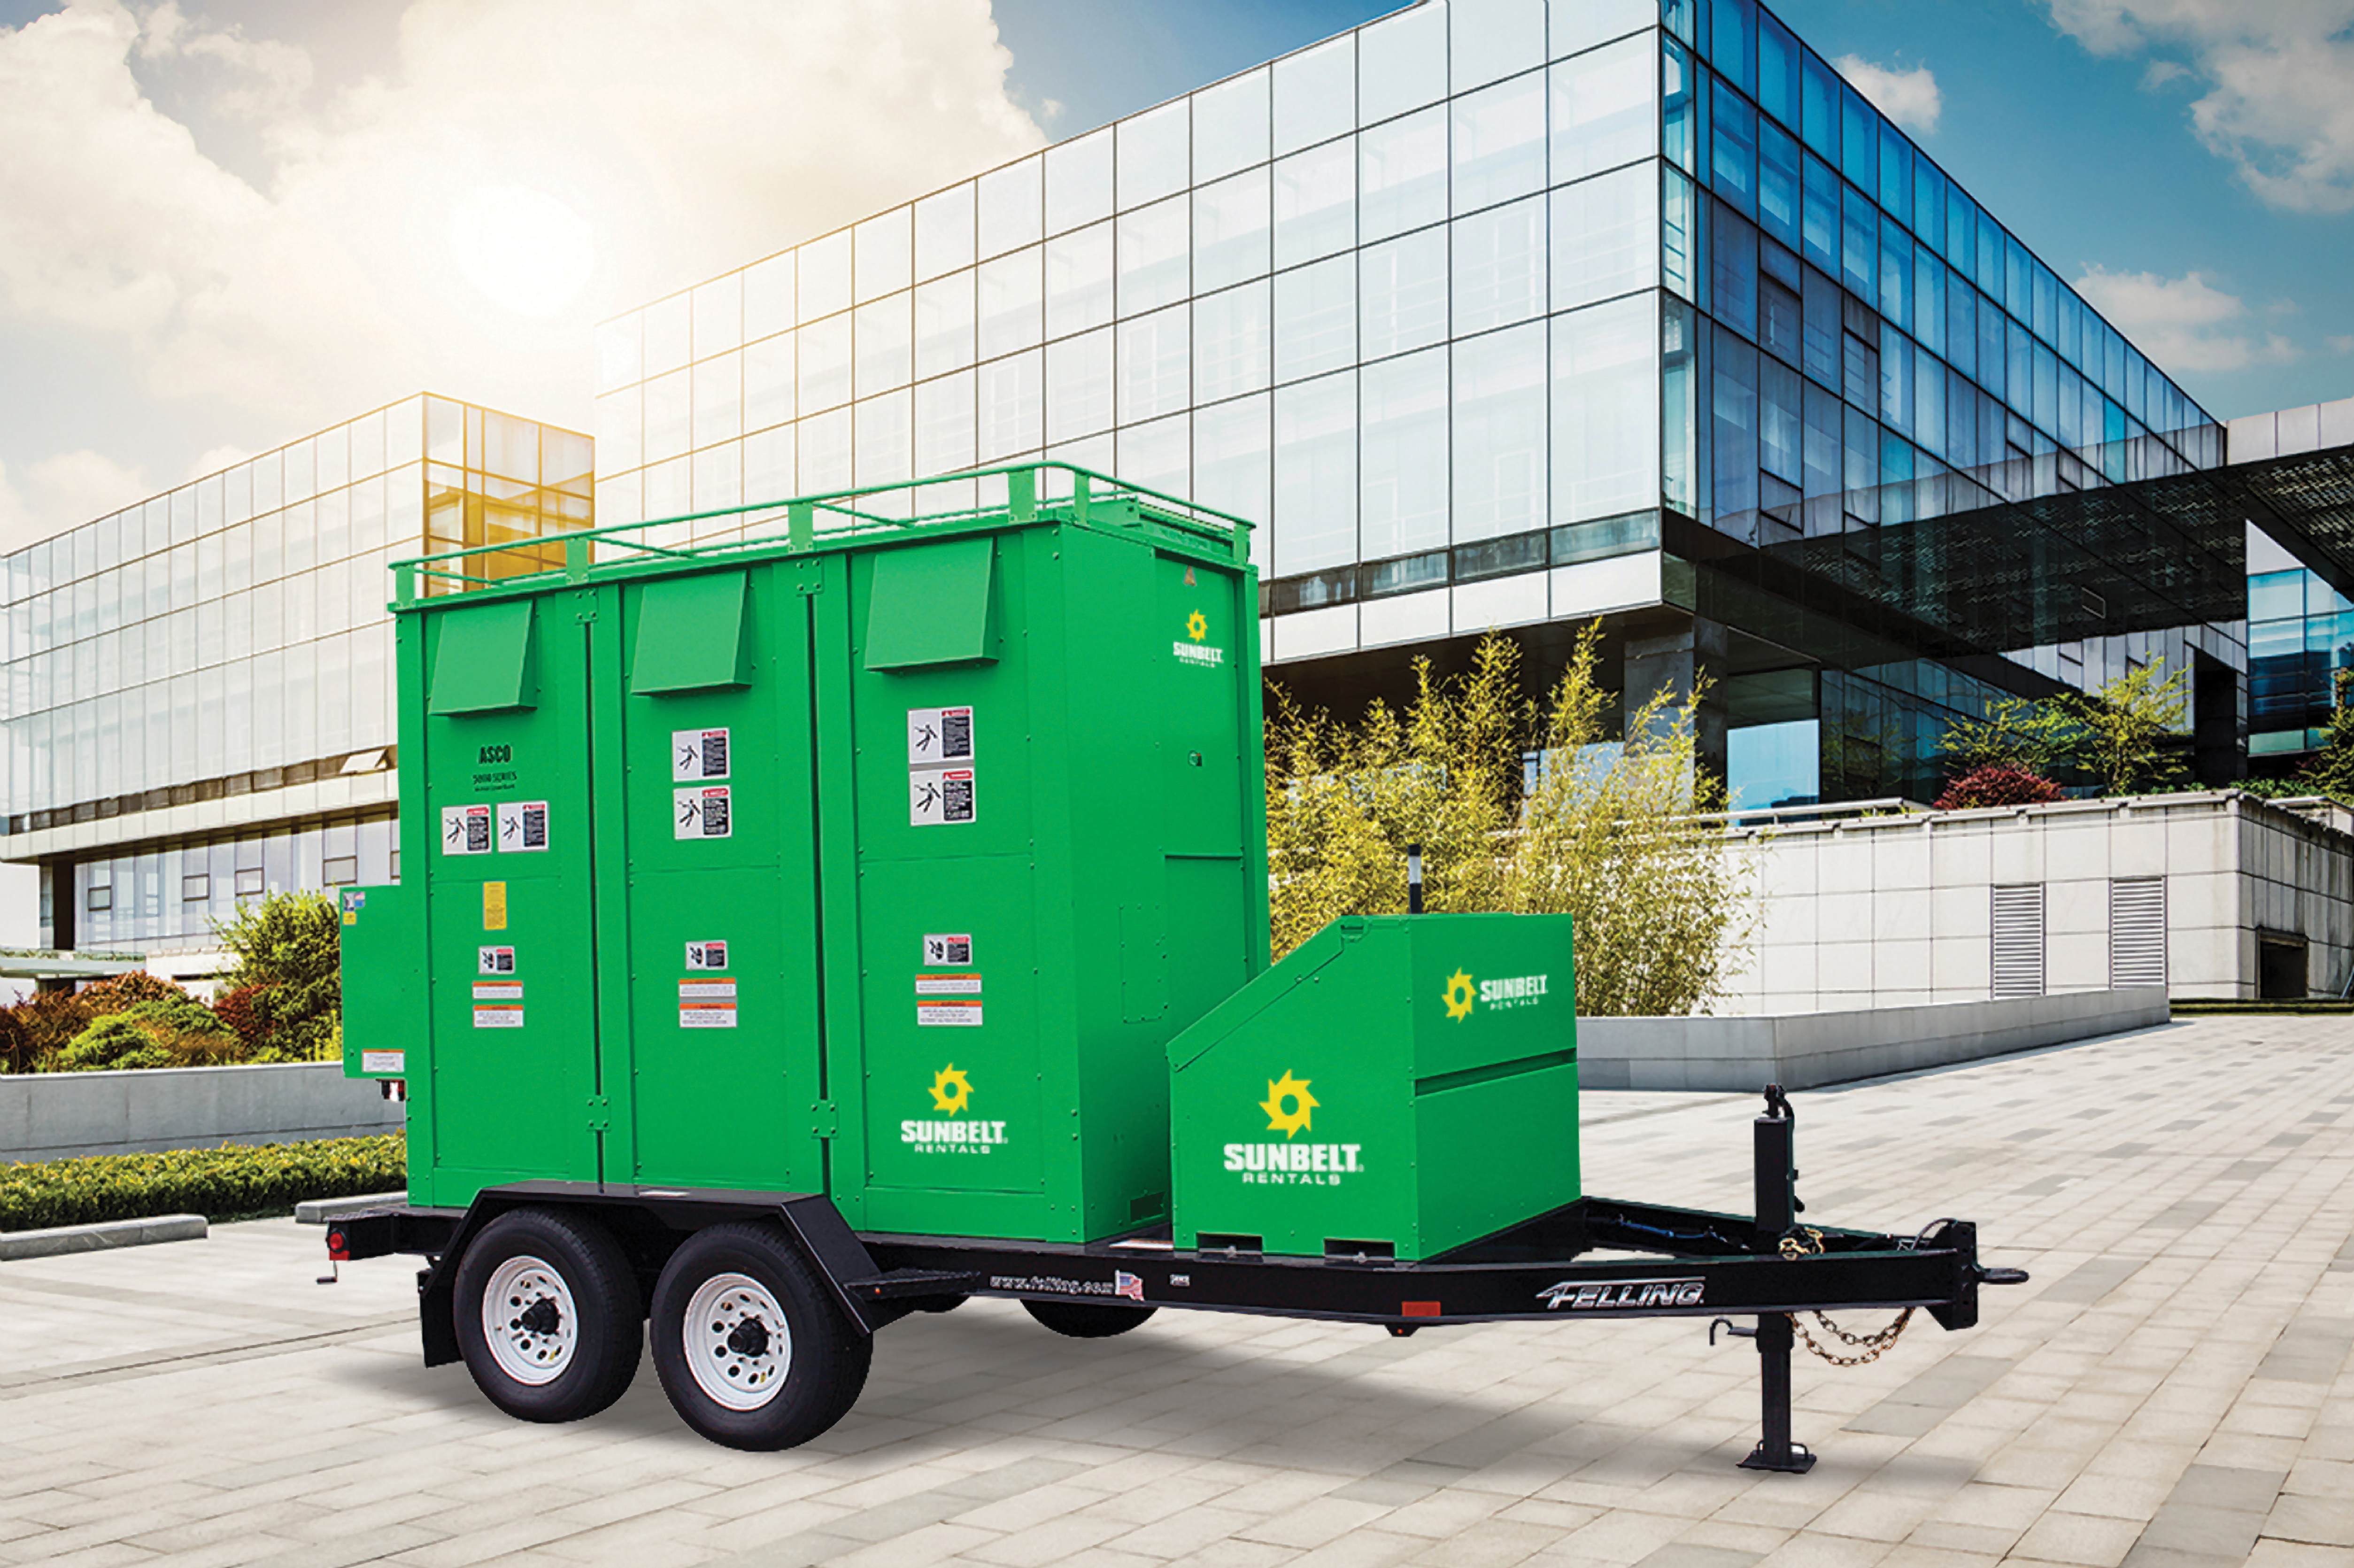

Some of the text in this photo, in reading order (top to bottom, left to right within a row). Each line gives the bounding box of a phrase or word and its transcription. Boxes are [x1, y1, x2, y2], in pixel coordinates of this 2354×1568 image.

[1173, 642, 1223, 663] SUNBELT
[479, 745, 511, 764] ASCO
[1480, 974, 1547, 1002] SUNBELT
[901, 1120, 1006, 1144] SUNBELT
[915, 1144, 990, 1154] RENTALS
[1223, 1143, 1361, 1172] SUNBELT
[1242, 1173, 1341, 1185] RENTALS
[1536, 1276, 1706, 1310] FELLING
